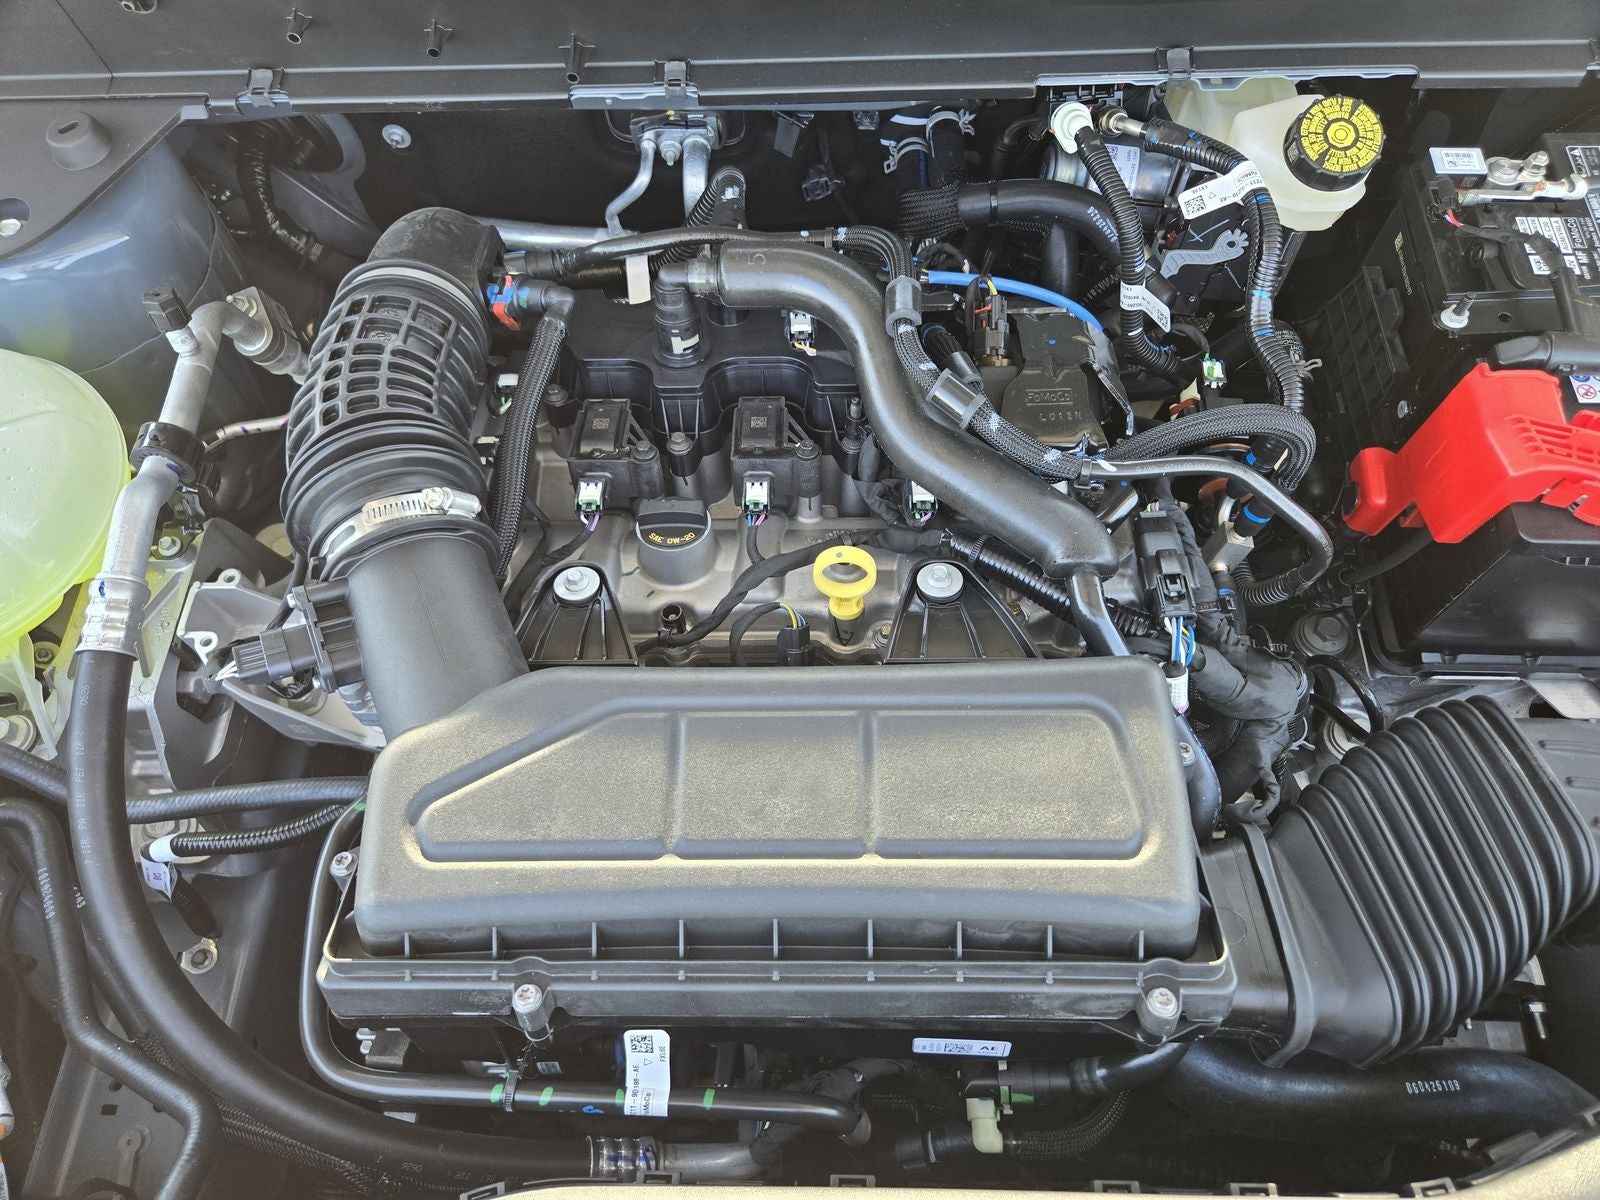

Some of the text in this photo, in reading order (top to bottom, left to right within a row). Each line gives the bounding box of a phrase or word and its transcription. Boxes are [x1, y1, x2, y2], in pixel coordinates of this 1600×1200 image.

[1567, 217, 1582, 247] FoMoCo
[1027, 391, 1071, 402] FoMoCo
[648, 532, 696, 544] SAE 0W-20
